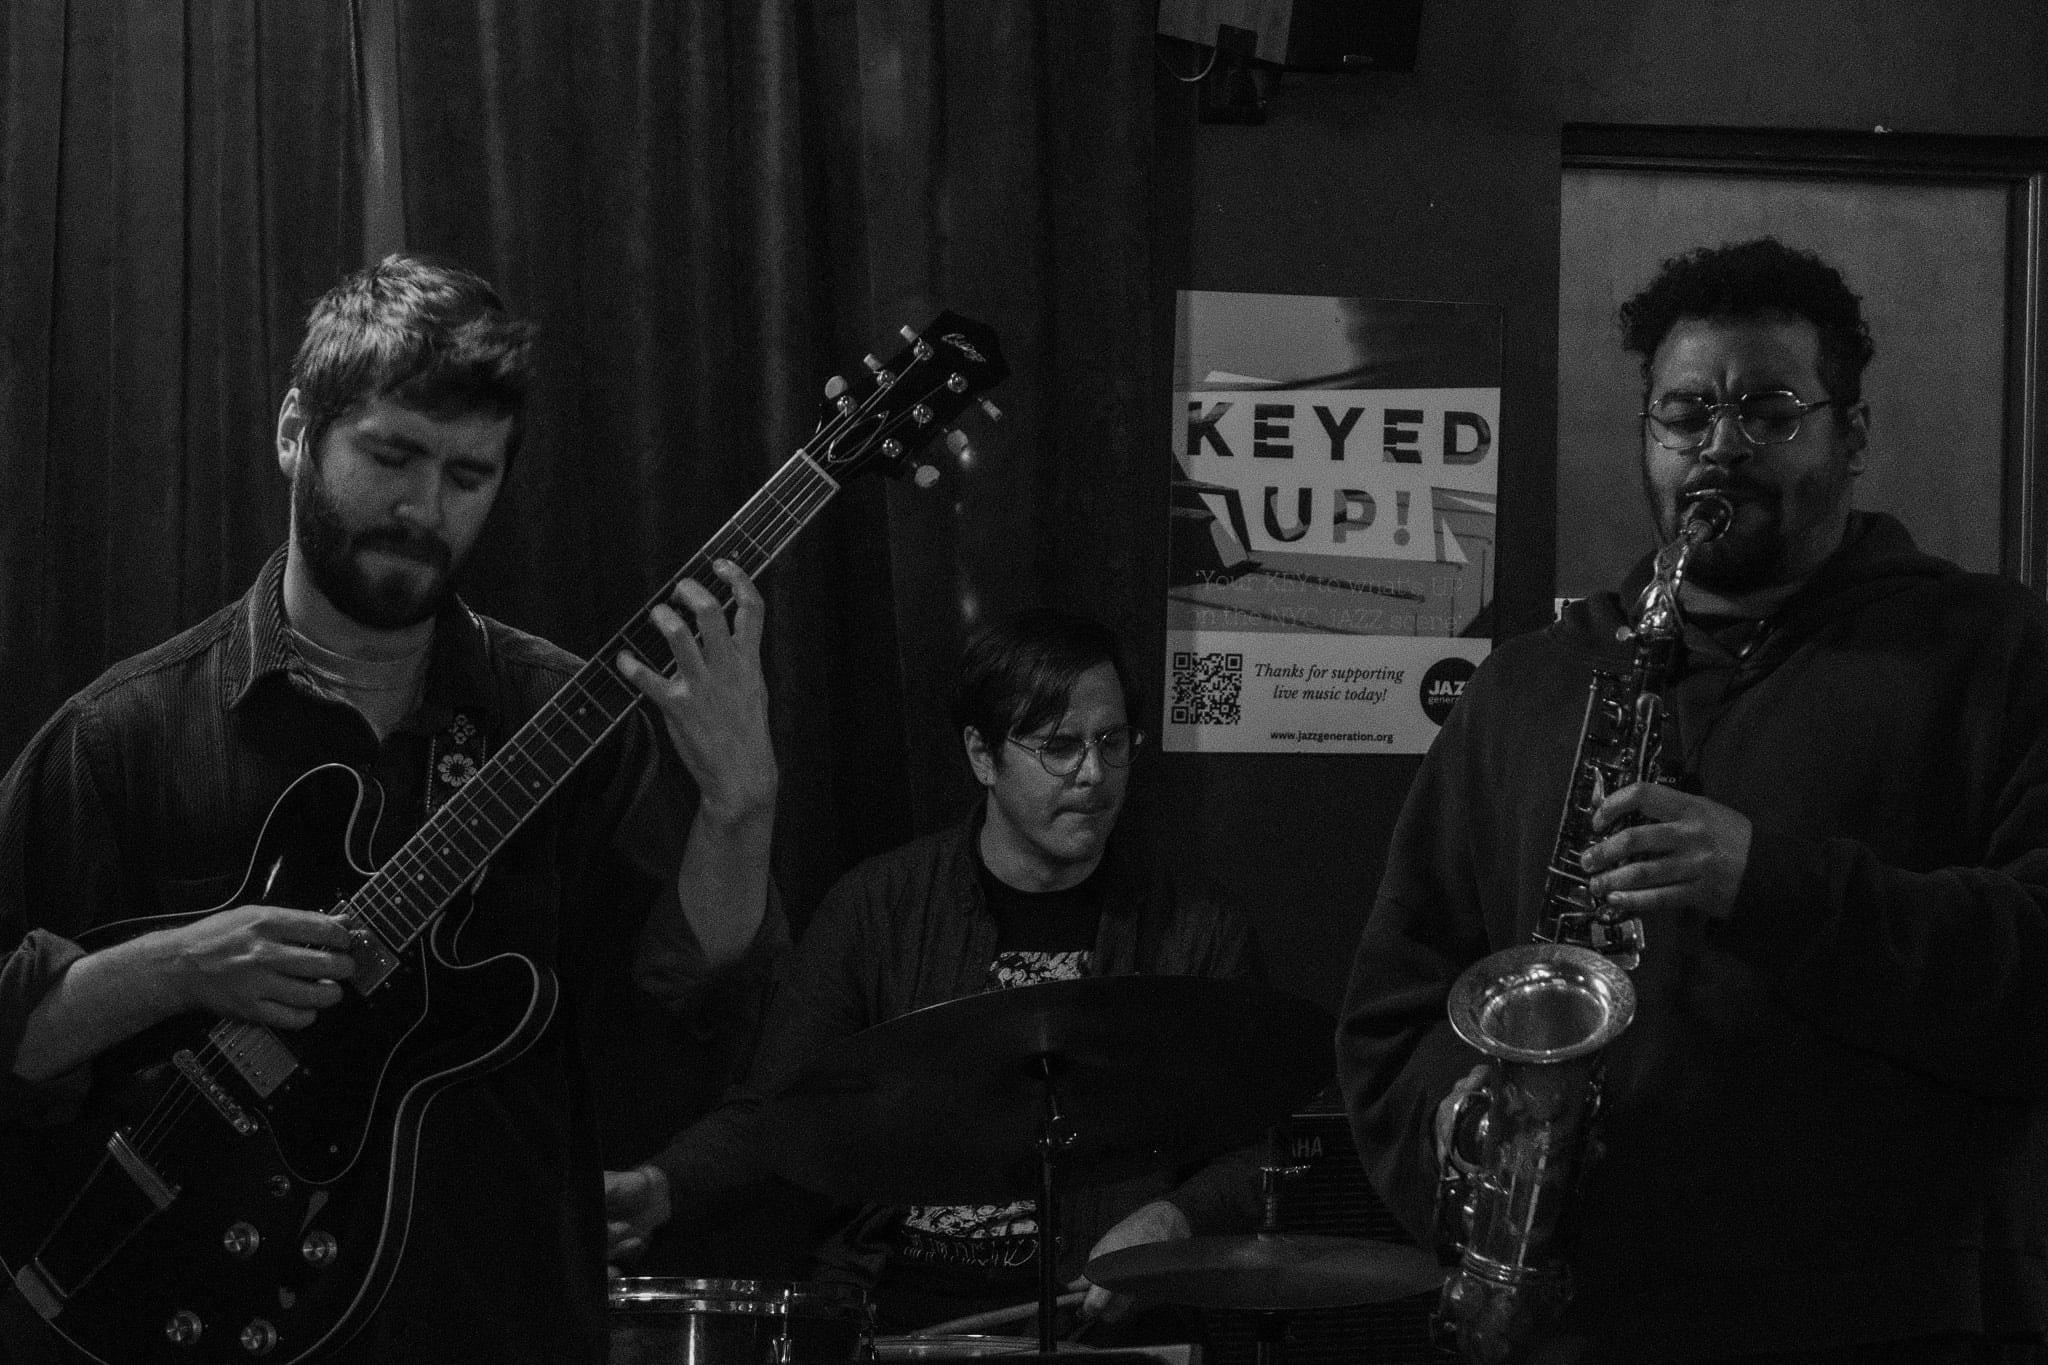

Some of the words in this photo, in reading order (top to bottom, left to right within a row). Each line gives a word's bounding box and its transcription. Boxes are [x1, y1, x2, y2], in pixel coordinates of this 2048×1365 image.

[1187, 401, 1491, 465] KEYED
[1264, 486, 1411, 547] UP!
[1328, 608, 1383, 629] JAZZ
[1255, 663, 1305, 678] Thanks
[1305, 664, 1329, 682] for
[1331, 666, 1404, 684] supporting
[1273, 685, 1299, 699] live
[1302, 686, 1341, 700] music
[1344, 687, 1388, 705] today!
[1428, 680, 1467, 695] JAZ
[1270, 731, 1394, 744] www.jazzgeneration.org
